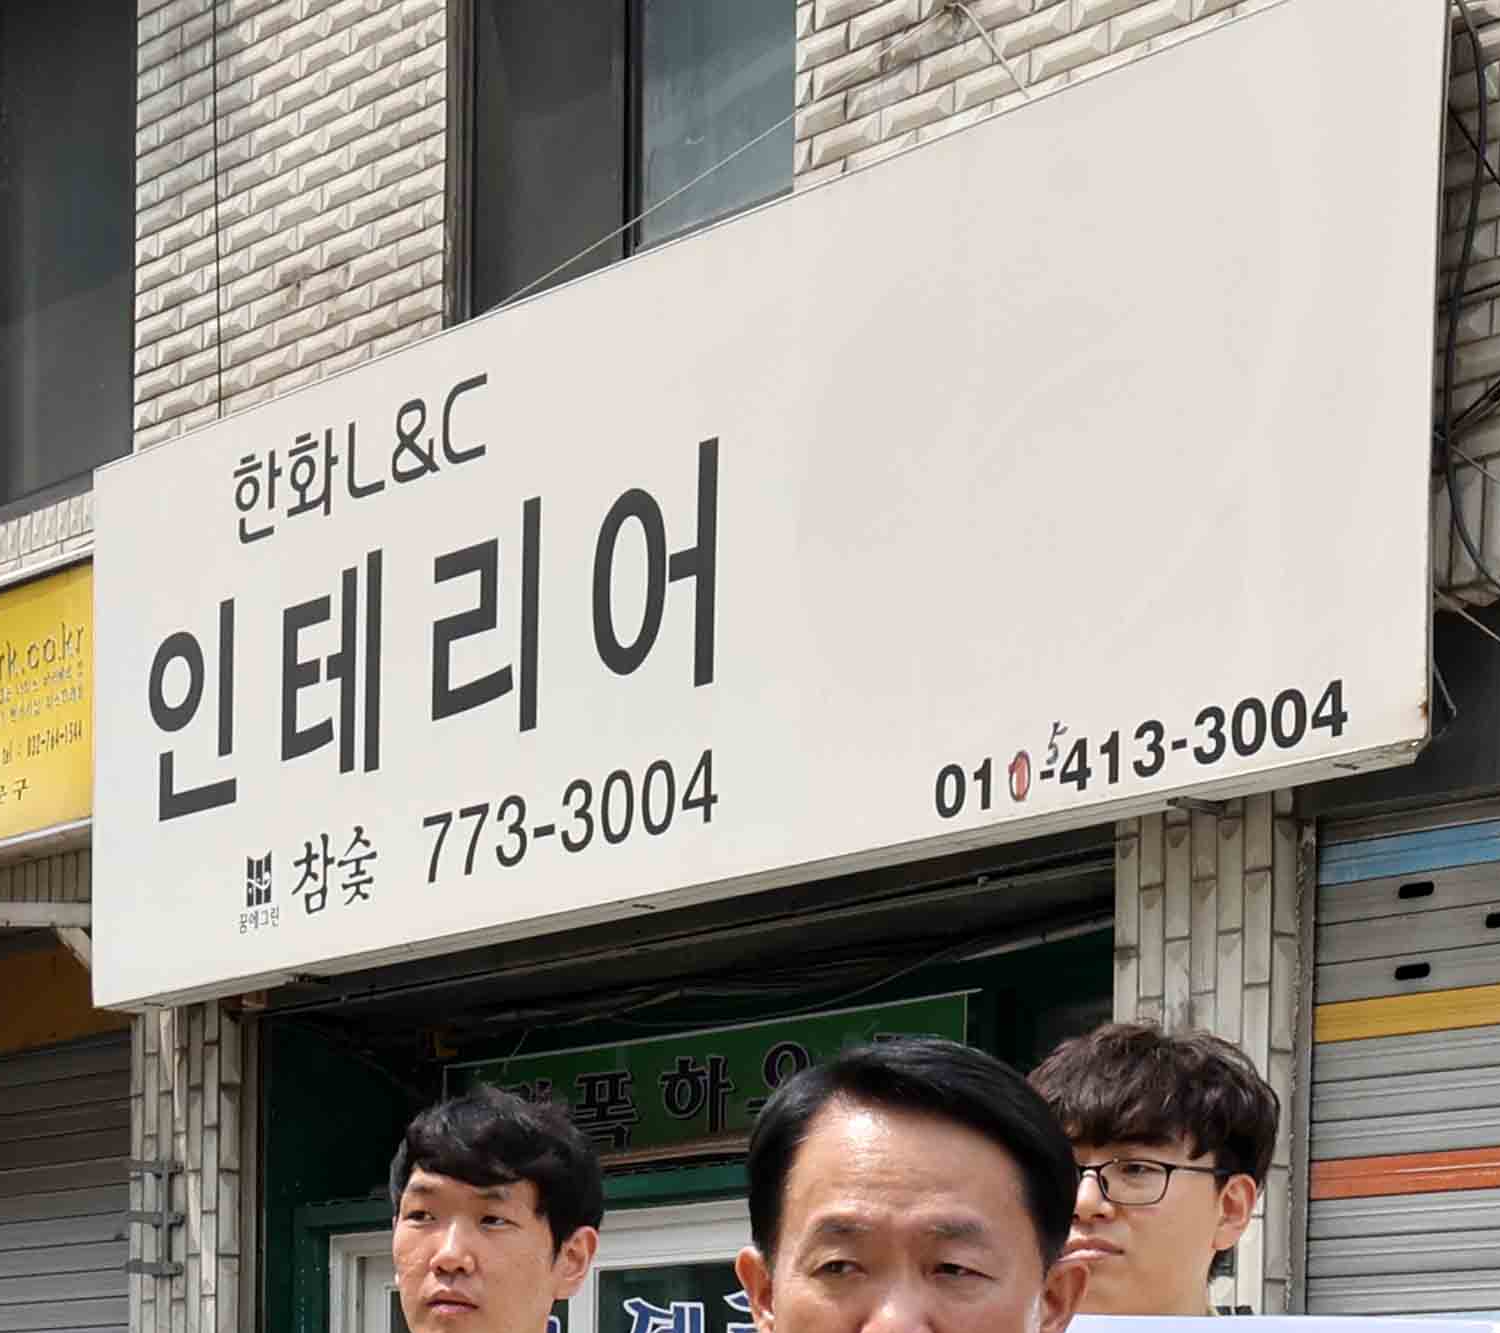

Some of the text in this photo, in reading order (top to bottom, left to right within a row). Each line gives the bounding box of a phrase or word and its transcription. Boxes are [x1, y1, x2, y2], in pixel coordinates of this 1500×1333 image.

[232, 372, 488, 545] 한화L&C
[148, 437, 720, 822] 인테리어
[935, 679, 1348, 818] 010-413-3004
[290, 750, 718, 915] 참숯 773-3004
[238, 905, 280, 935] 꿈에그린
